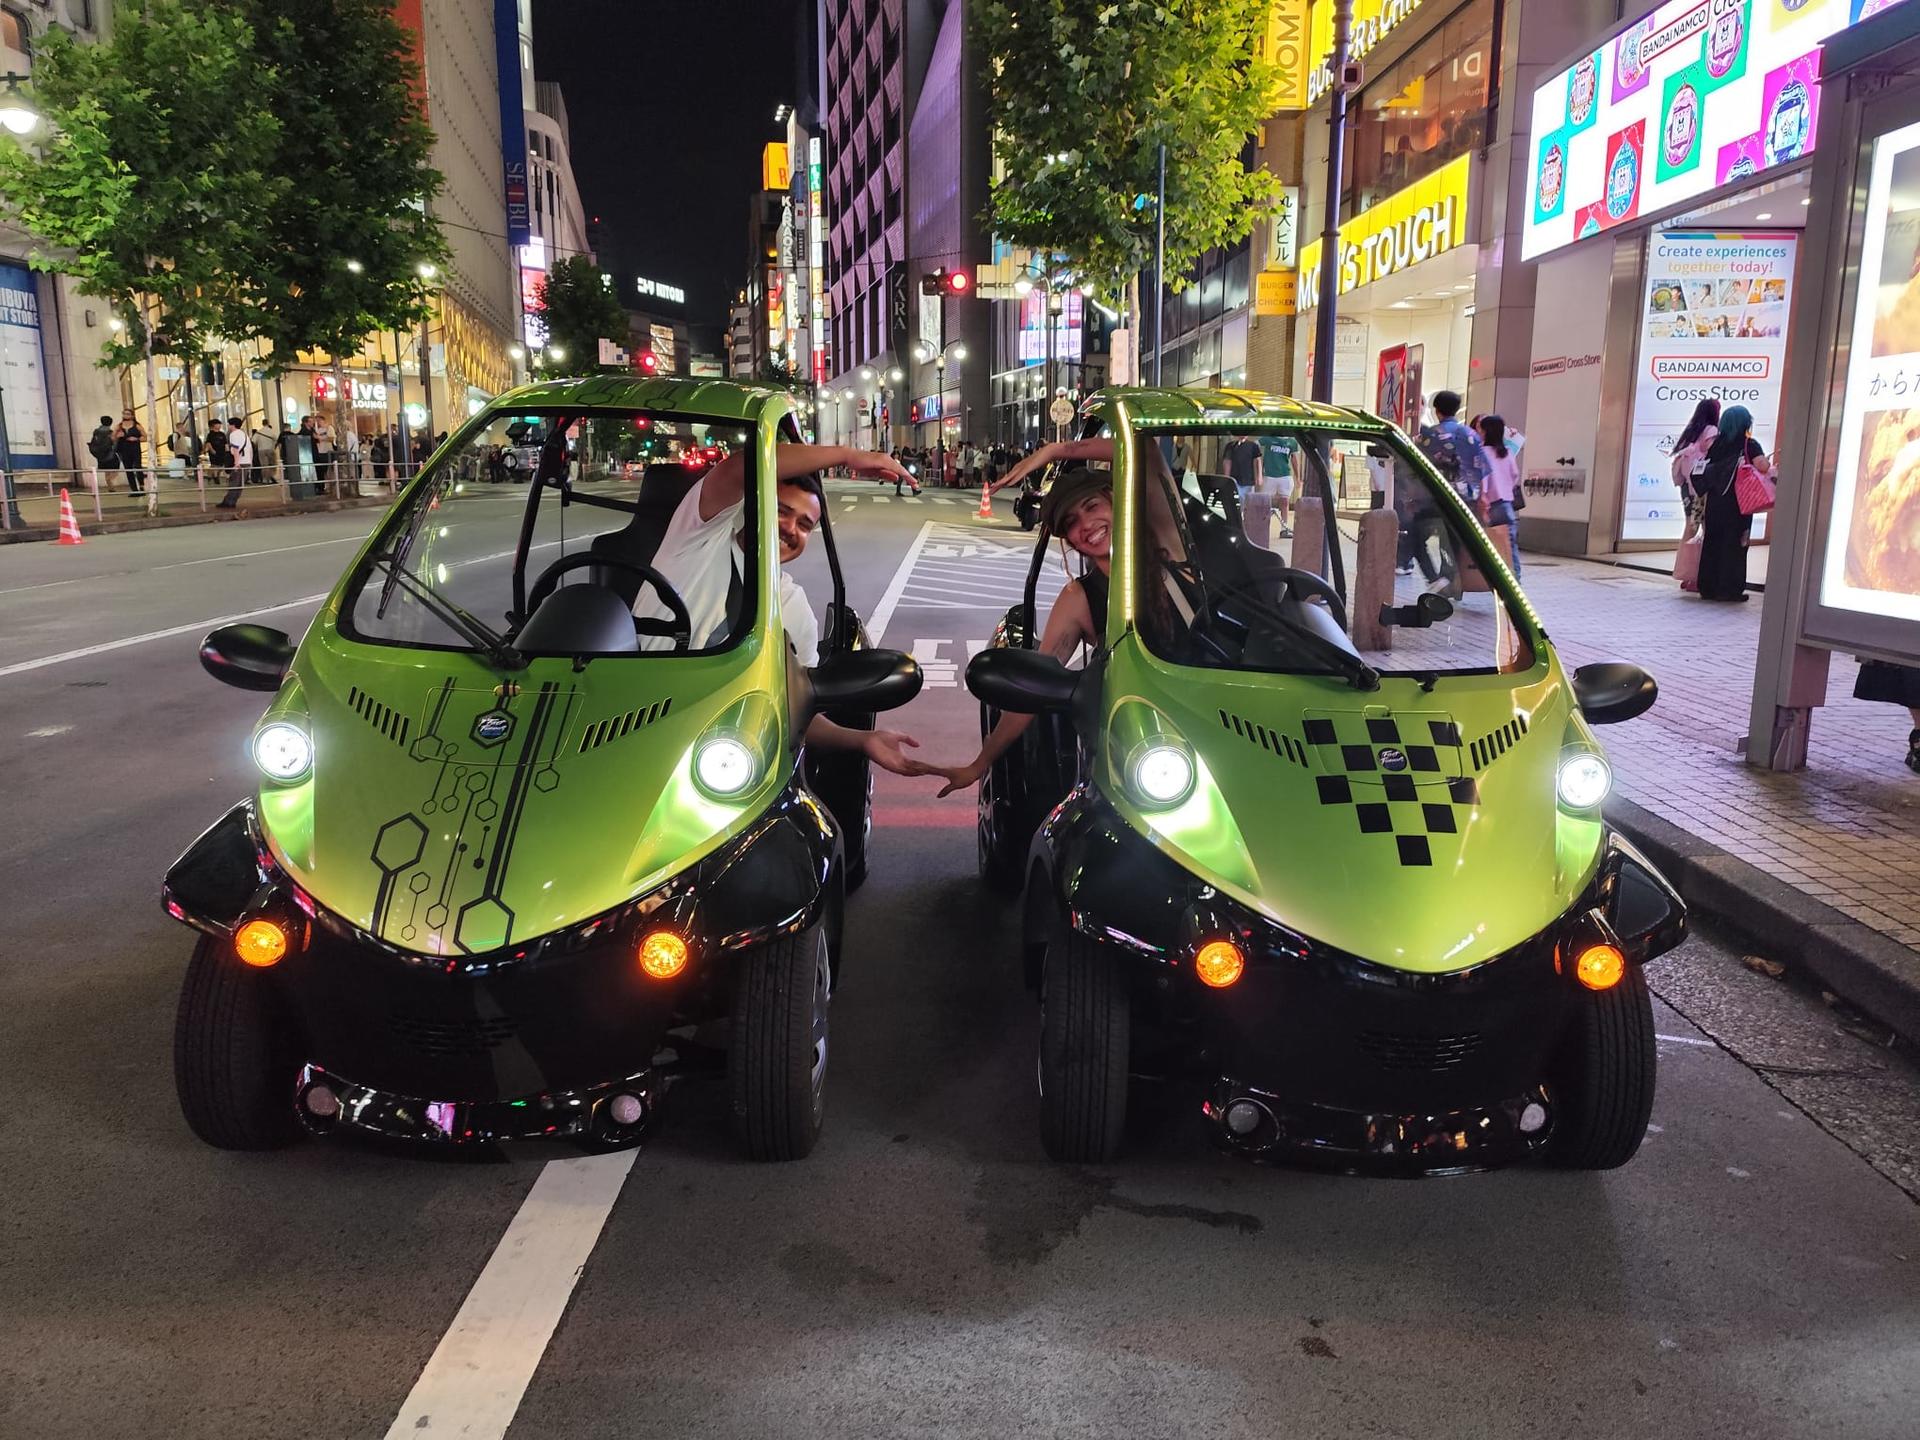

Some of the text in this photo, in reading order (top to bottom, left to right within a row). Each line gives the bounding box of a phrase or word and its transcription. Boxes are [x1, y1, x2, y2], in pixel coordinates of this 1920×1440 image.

[1367, 16, 1376, 45] &
[1642, 28, 1672, 57] BANDAI
[1673, 9, 1706, 38] NAMCO
[782, 196, 794, 268] KARAOKE
[1362, 195, 1456, 281] TOUCH
[1658, 245, 1787, 259] Create experiences
[1668, 261, 1774, 275] together today!
[1260, 282, 1294, 290] BURGER
[894, 273, 906, 330] ZARA
[1259, 298, 1296, 307] CHICKEN
[1658, 362, 1763, 373] BANDAI NAMCO
[1656, 385, 1760, 401] Cross Store
